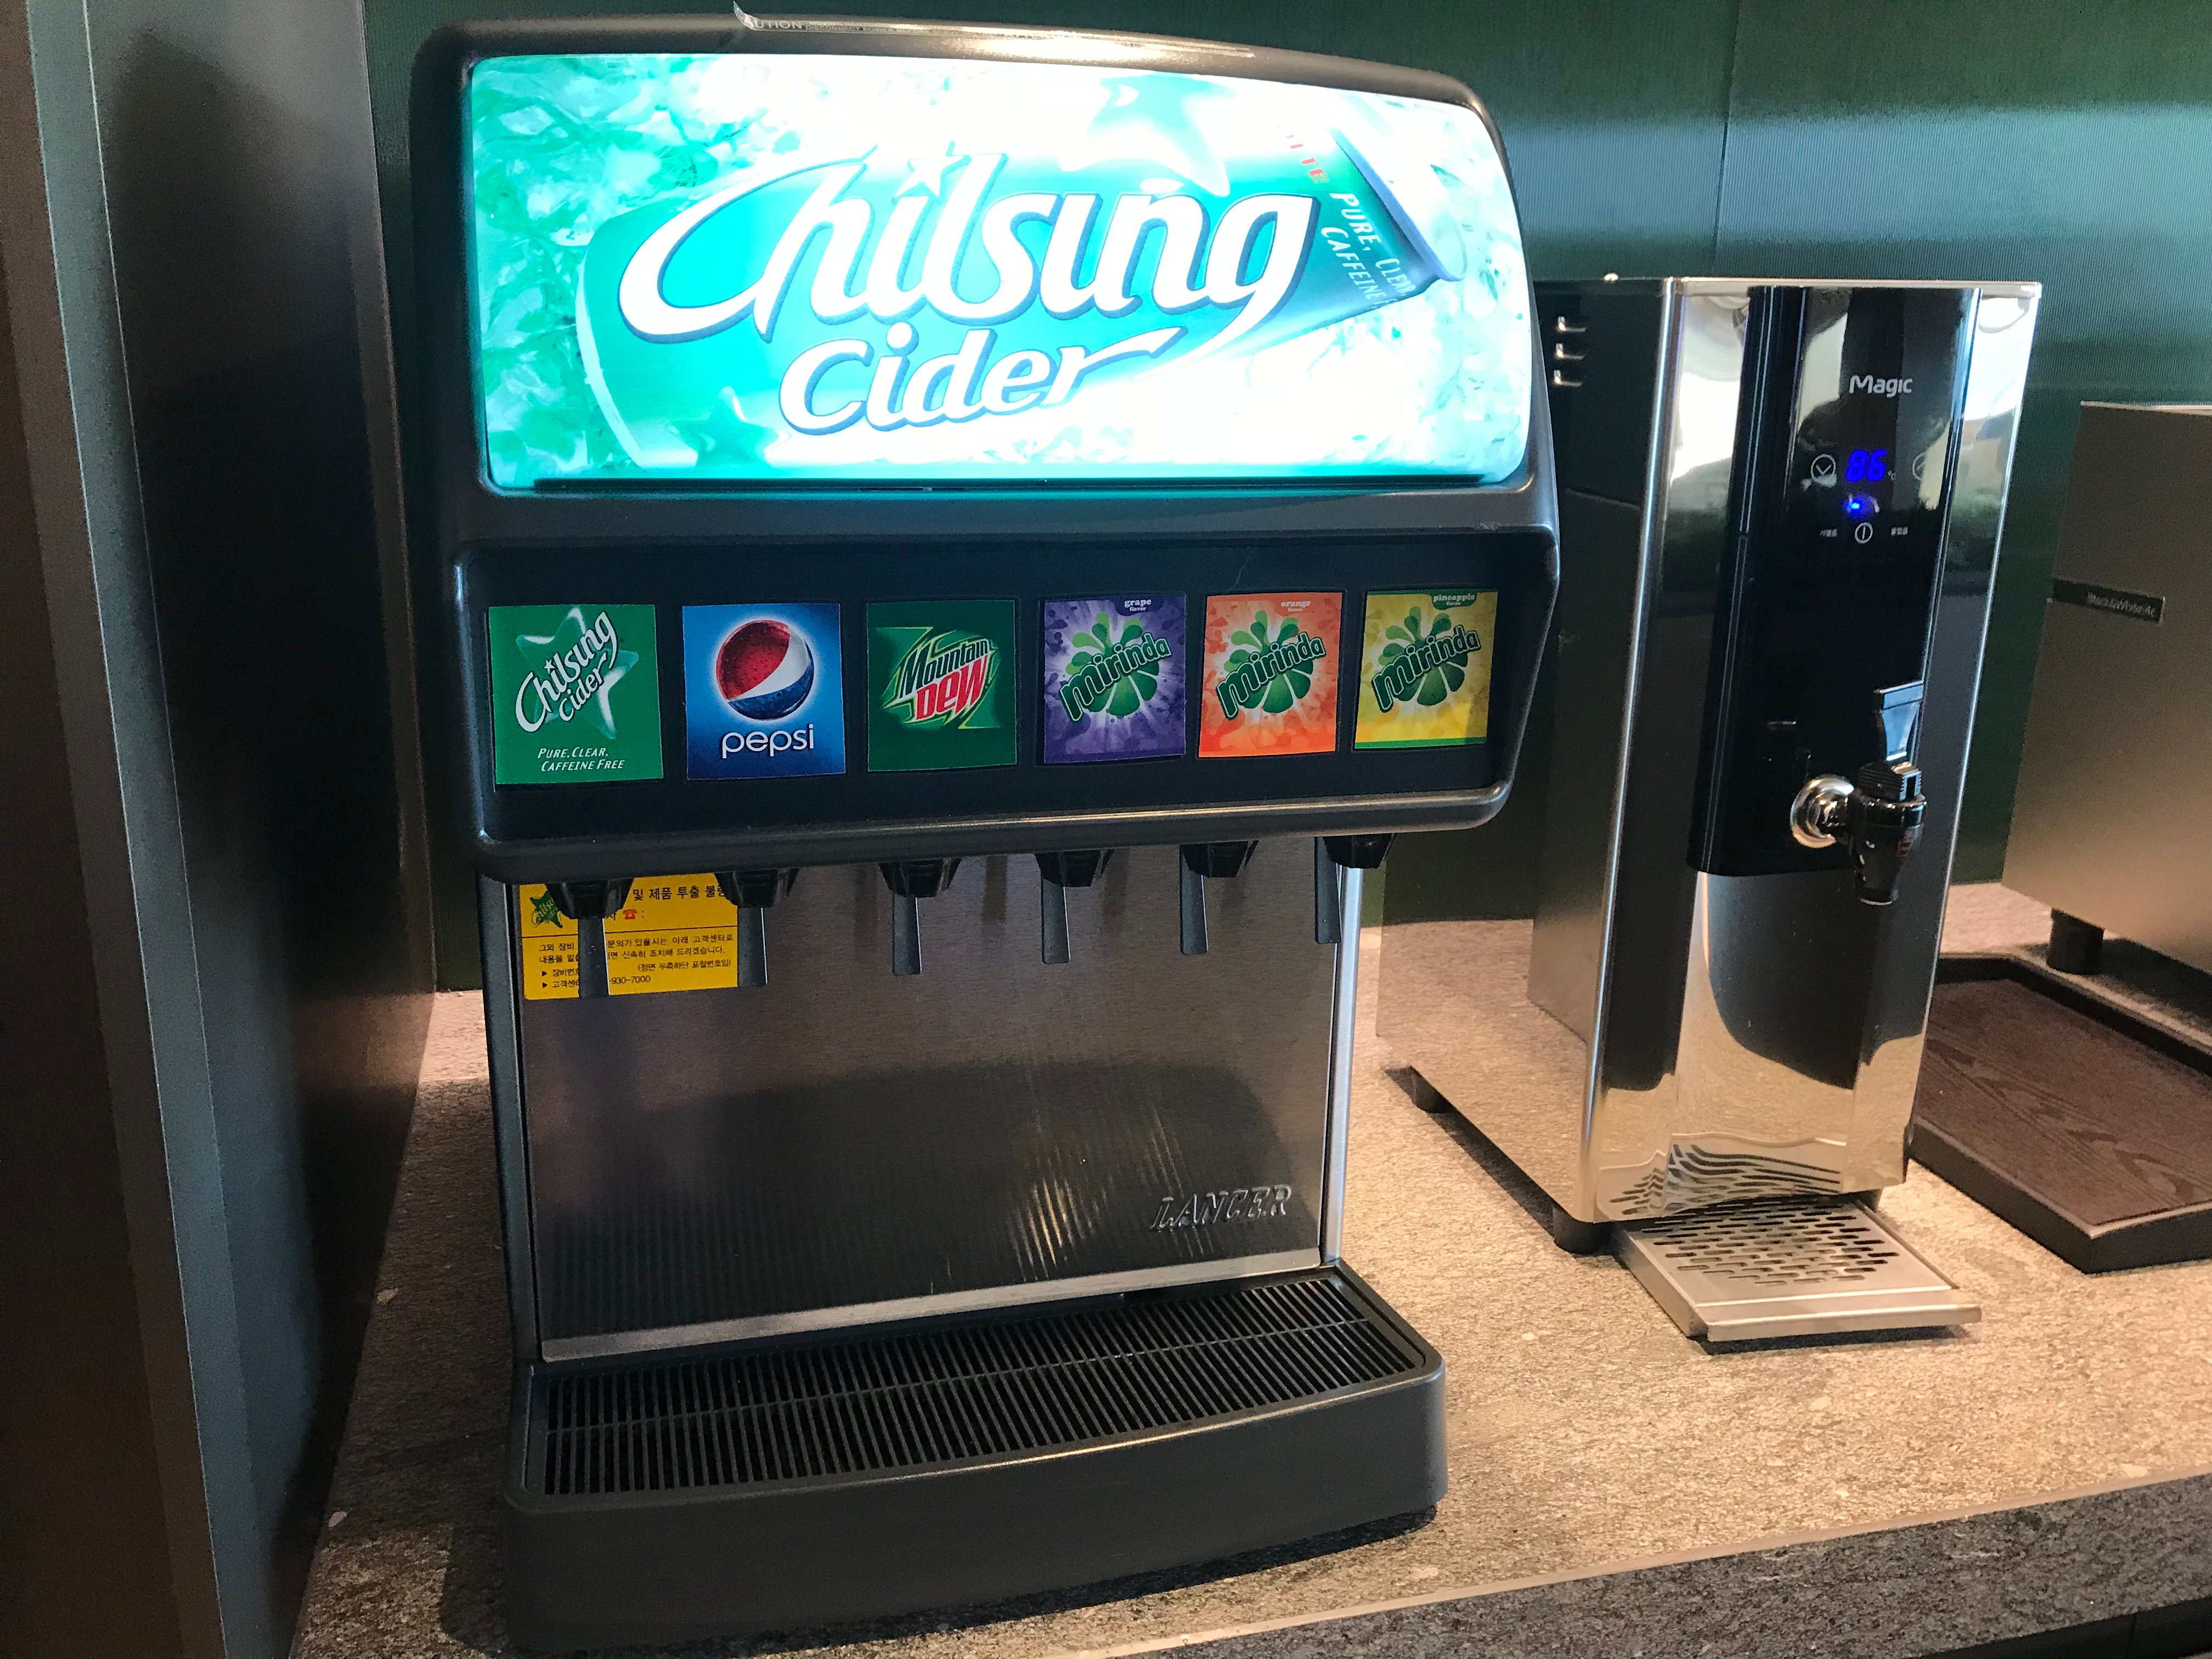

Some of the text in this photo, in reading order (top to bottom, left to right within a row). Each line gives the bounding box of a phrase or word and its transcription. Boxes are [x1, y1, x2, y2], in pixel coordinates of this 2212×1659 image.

[734, 7, 803, 29] CAUTION
[1329, 192, 1381, 251] PURE,
[617, 143, 1319, 379] Chilsung
[1321, 227, 1387, 300] CAFFEINE
[1849, 374, 1914, 398] Magic
[1845, 449, 1887, 482] 86
[1124, 599, 1152, 608] grape
[516, 611, 618, 732] Chilsung
[898, 639, 990, 700] Mountain
[1059, 632, 1172, 722] mirinda
[1216, 632, 1326, 719] mirinda
[1372, 624, 1481, 710] mirinda
[721, 723, 814, 759] pepsi
[541, 758, 626, 772] CAFFEINE FREE
[633, 888, 644, 901] 및
[649, 887, 673, 900] 제품
[677, 885, 701, 899] 투출
[539, 954, 563, 964] 내용을
[622, 950, 646, 960] 신속히
[649, 948, 673, 957] 조치해
[558, 943, 574, 951] 장비
[607, 939, 633, 949] 문의가
[672, 935, 689, 944] 아래
[693, 934, 733, 943] 고객센타로
[1149, 1184, 1292, 1229] LANCER
